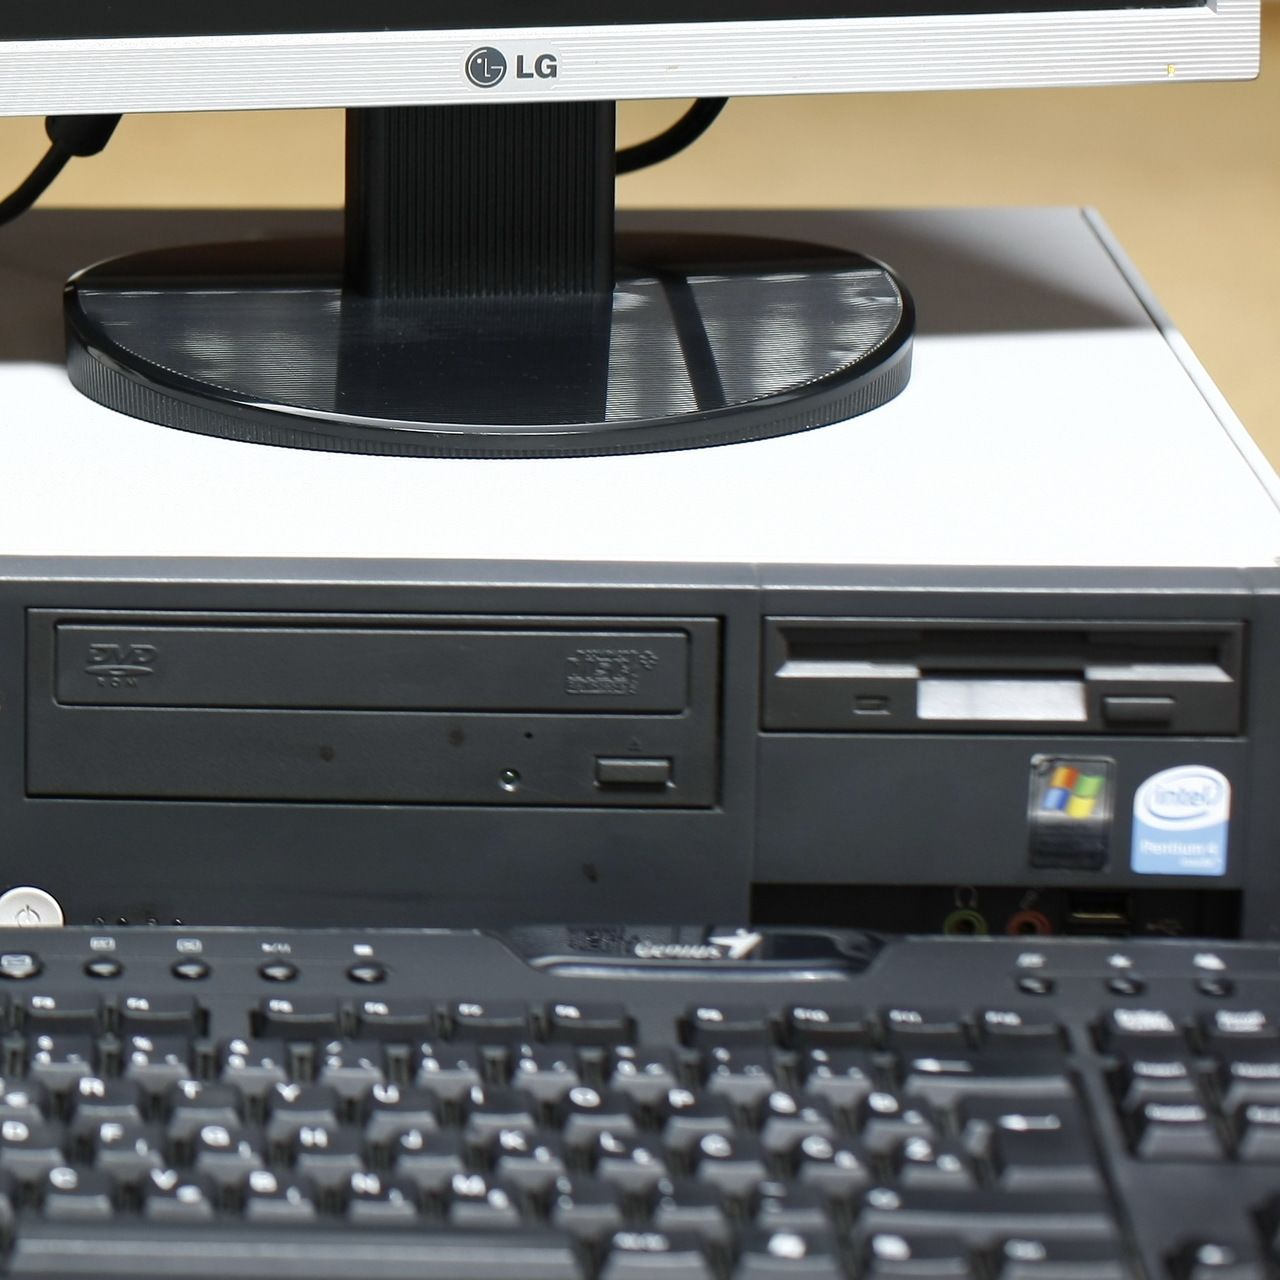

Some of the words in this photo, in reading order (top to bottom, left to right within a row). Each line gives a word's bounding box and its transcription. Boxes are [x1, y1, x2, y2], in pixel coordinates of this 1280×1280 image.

[516, 54, 557, 78] LG
[88, 643, 158, 664] DVD
[1154, 784, 1212, 807] intel
